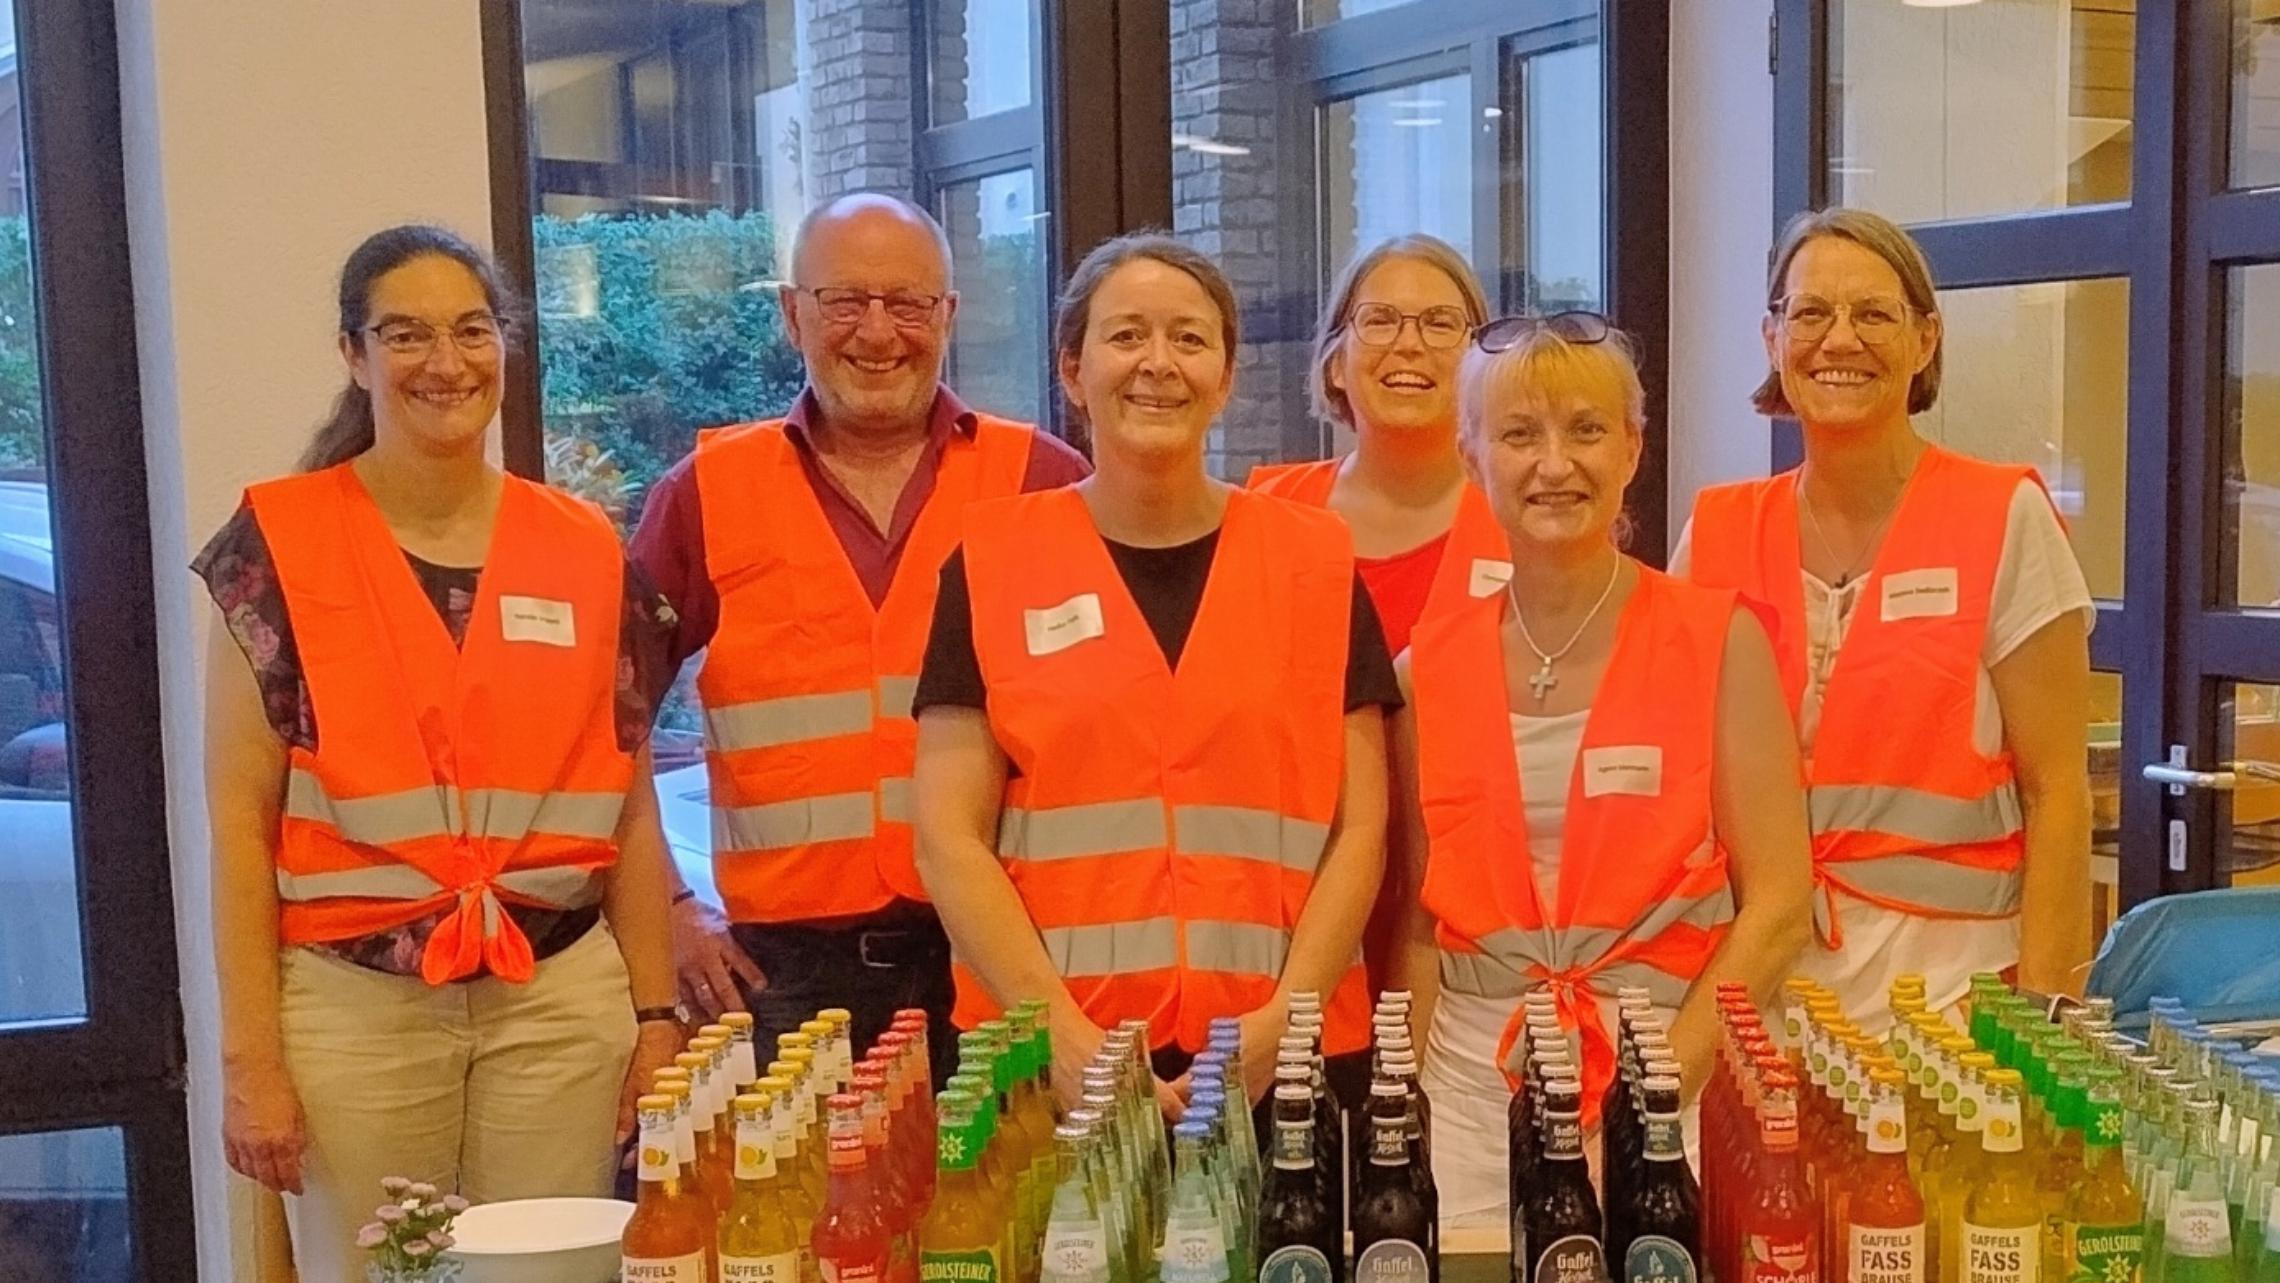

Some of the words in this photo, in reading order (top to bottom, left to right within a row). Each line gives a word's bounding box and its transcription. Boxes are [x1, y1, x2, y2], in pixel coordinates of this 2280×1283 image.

[1861, 1234, 1912, 1247] GAFFELS
[1971, 1233, 2021, 1248] GAFFELS
[1372, 1256, 1413, 1274] Gaffel
[1556, 1251, 1595, 1269] Gaffel
[1861, 1250, 1912, 1270] FASS
[1971, 1250, 2021, 1271] FASS
